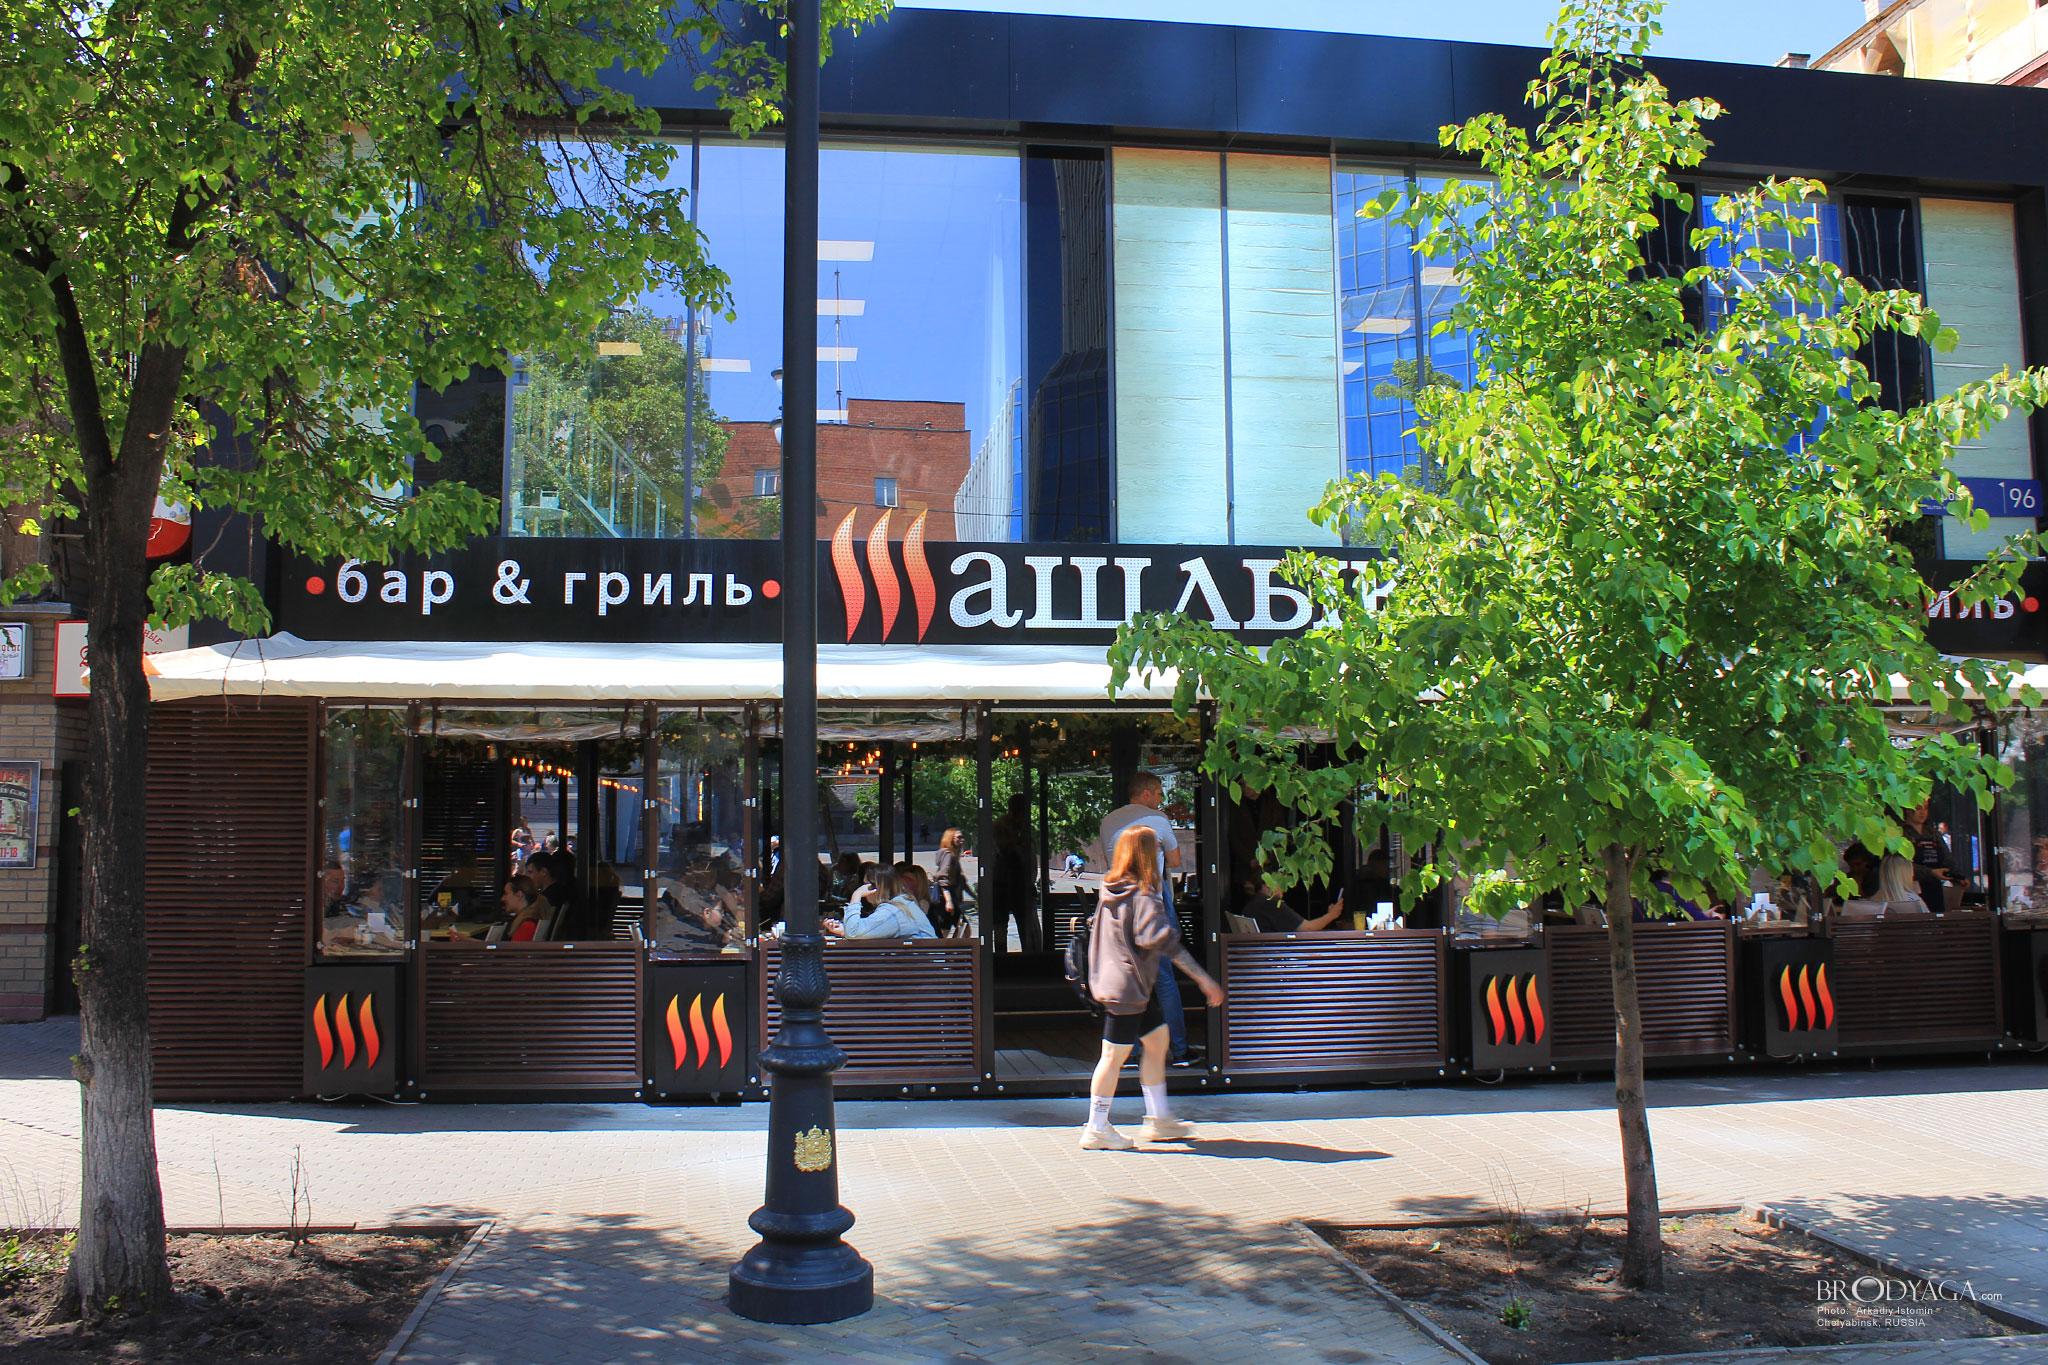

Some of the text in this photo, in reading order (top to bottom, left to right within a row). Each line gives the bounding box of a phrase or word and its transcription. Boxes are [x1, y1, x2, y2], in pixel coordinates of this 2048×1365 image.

[2009, 488, 2036, 509] 96
[336, 559, 753, 616] бар & гриль
